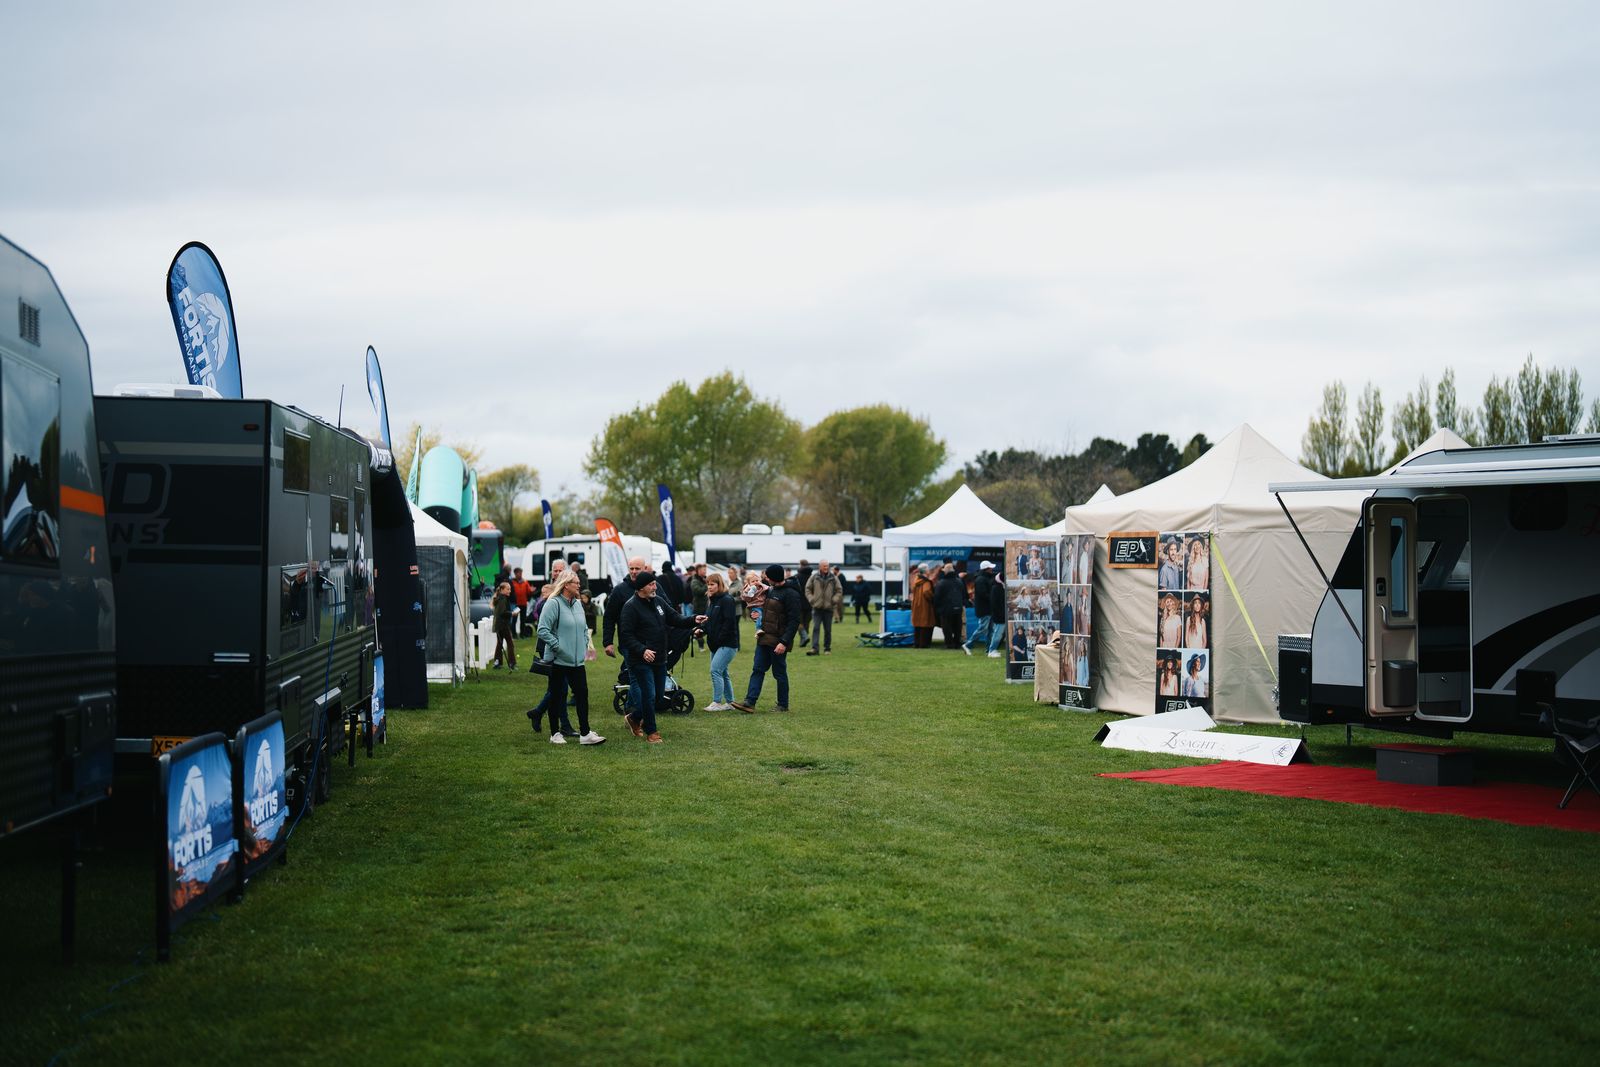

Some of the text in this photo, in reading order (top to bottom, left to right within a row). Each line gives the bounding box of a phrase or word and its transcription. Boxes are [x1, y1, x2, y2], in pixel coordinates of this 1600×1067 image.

[178, 286, 217, 390] FORTIS
[111, 522, 161, 544] NS
[250, 790, 279, 829] FORTIS
[173, 823, 213, 871] FORTIS
